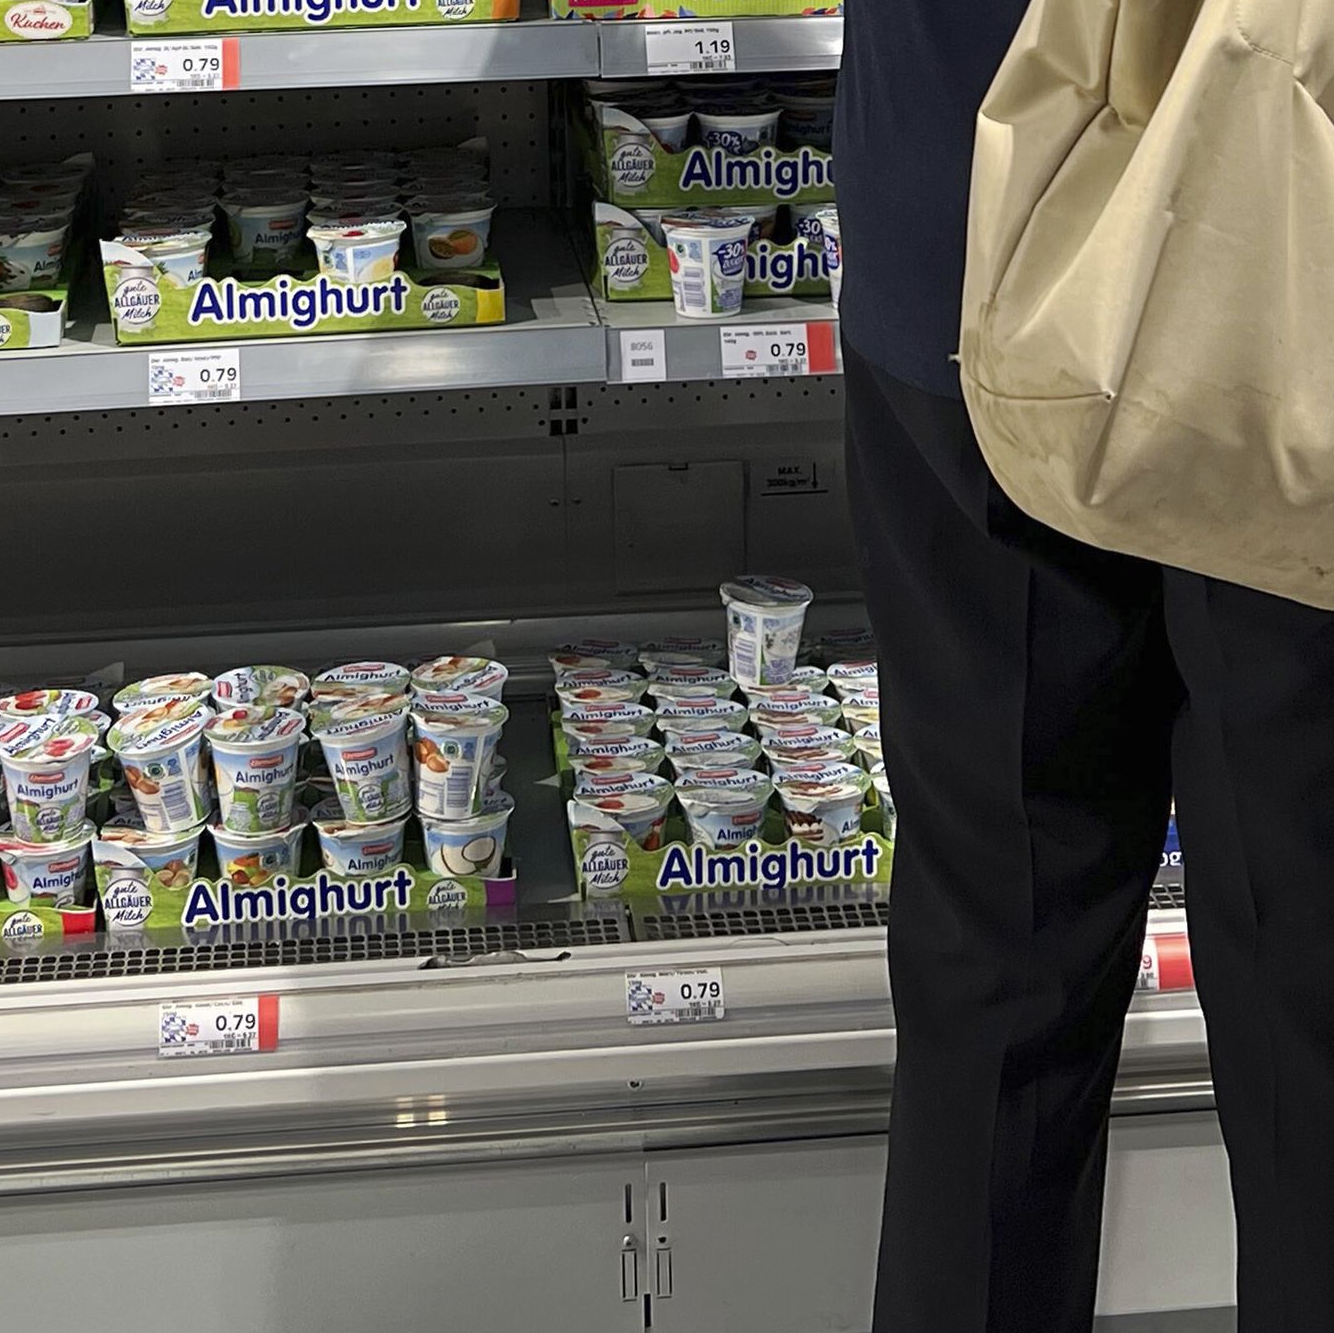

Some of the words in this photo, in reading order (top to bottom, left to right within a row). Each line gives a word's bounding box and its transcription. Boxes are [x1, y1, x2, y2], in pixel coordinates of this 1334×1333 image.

[10, 12, 66, 32] Kuchen
[695, 39, 731, 55] 1.19
[770, 343, 806, 358] 0.79
[658, 838, 881, 889] Almighurt
[184, 873, 412, 926] Almighurt
[680, 982, 721, 999] 0.79
[213, 1014, 257, 1032] 0.79
